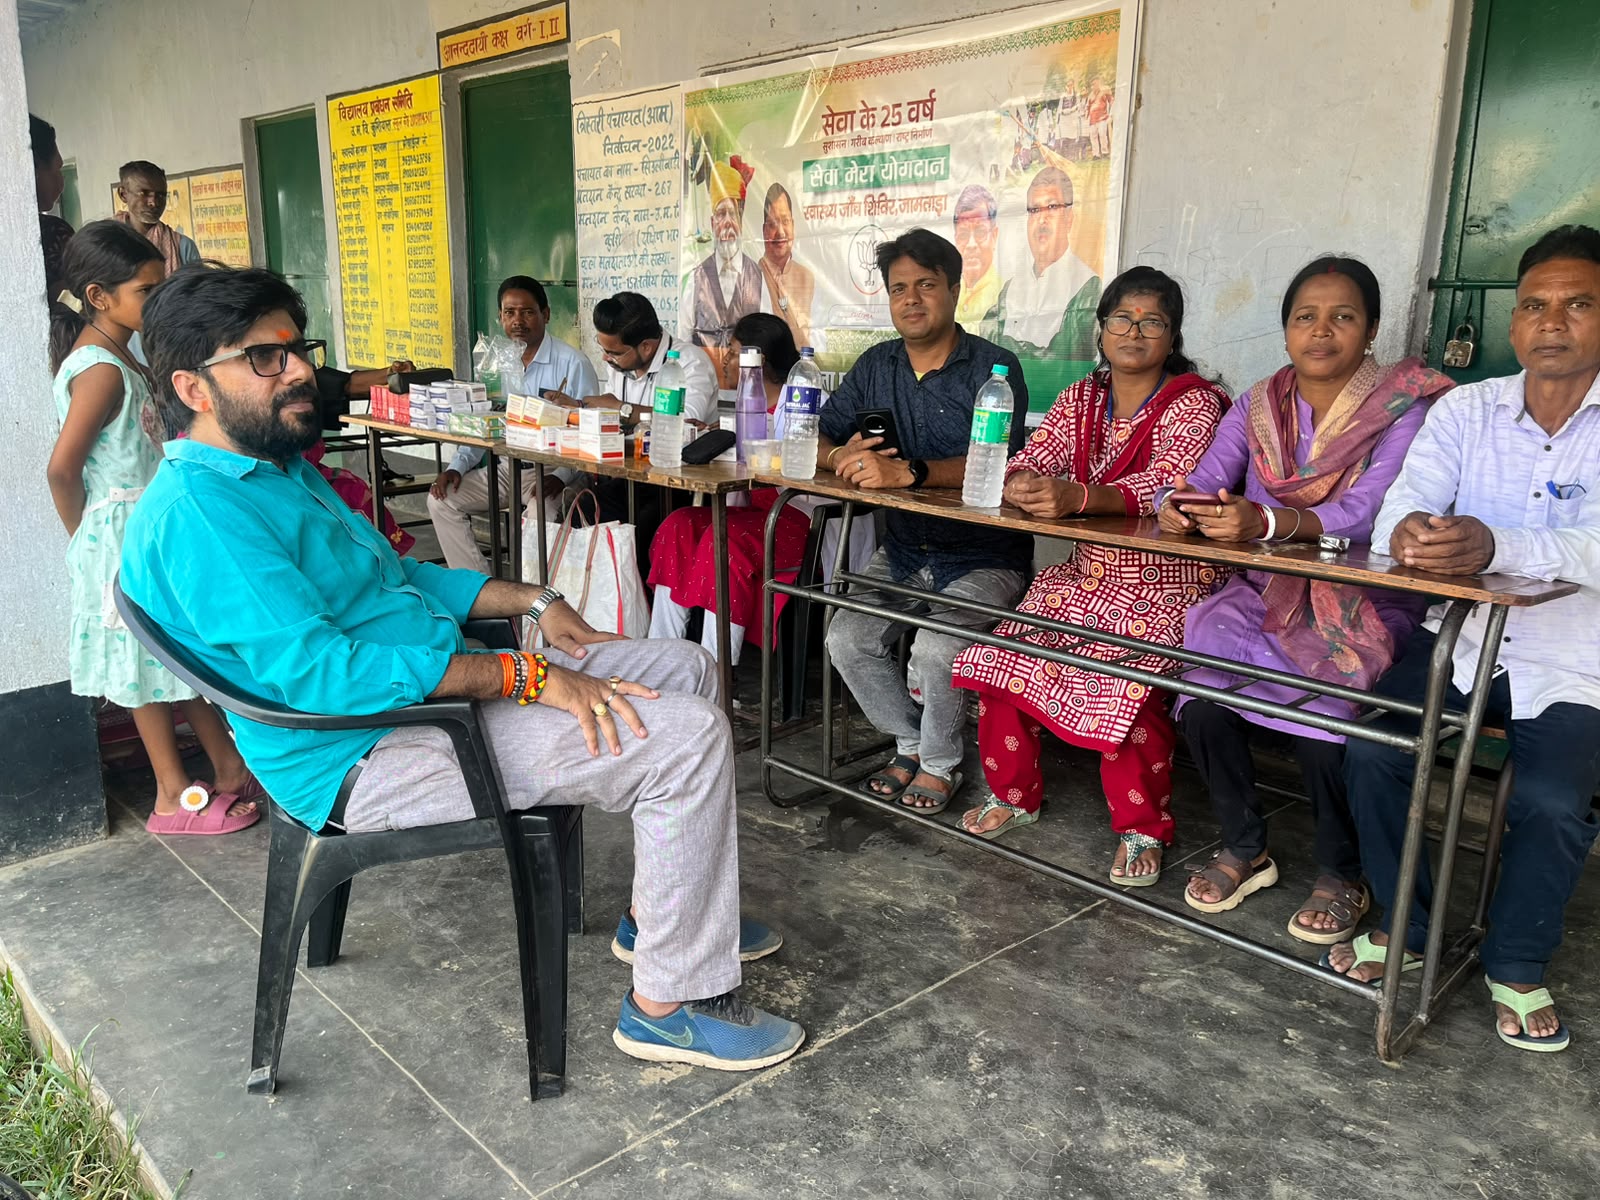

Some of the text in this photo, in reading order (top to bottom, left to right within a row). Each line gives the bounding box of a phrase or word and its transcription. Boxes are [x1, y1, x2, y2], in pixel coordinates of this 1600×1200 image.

[492, 29, 509, 49] कक्ष
[338, 101, 369, 120] विद्यालय
[821, 88, 936, 136] सेवा के 25 वर्ष
[822, 127, 933, 154] सुशासन गरीब कल्याण राष्ट्र निर्माण
[809, 156, 947, 187] सेवा मेरा योगदान
[803, 203, 837, 220] स्वास्थ्य
[840, 196, 861, 218] जाँच
